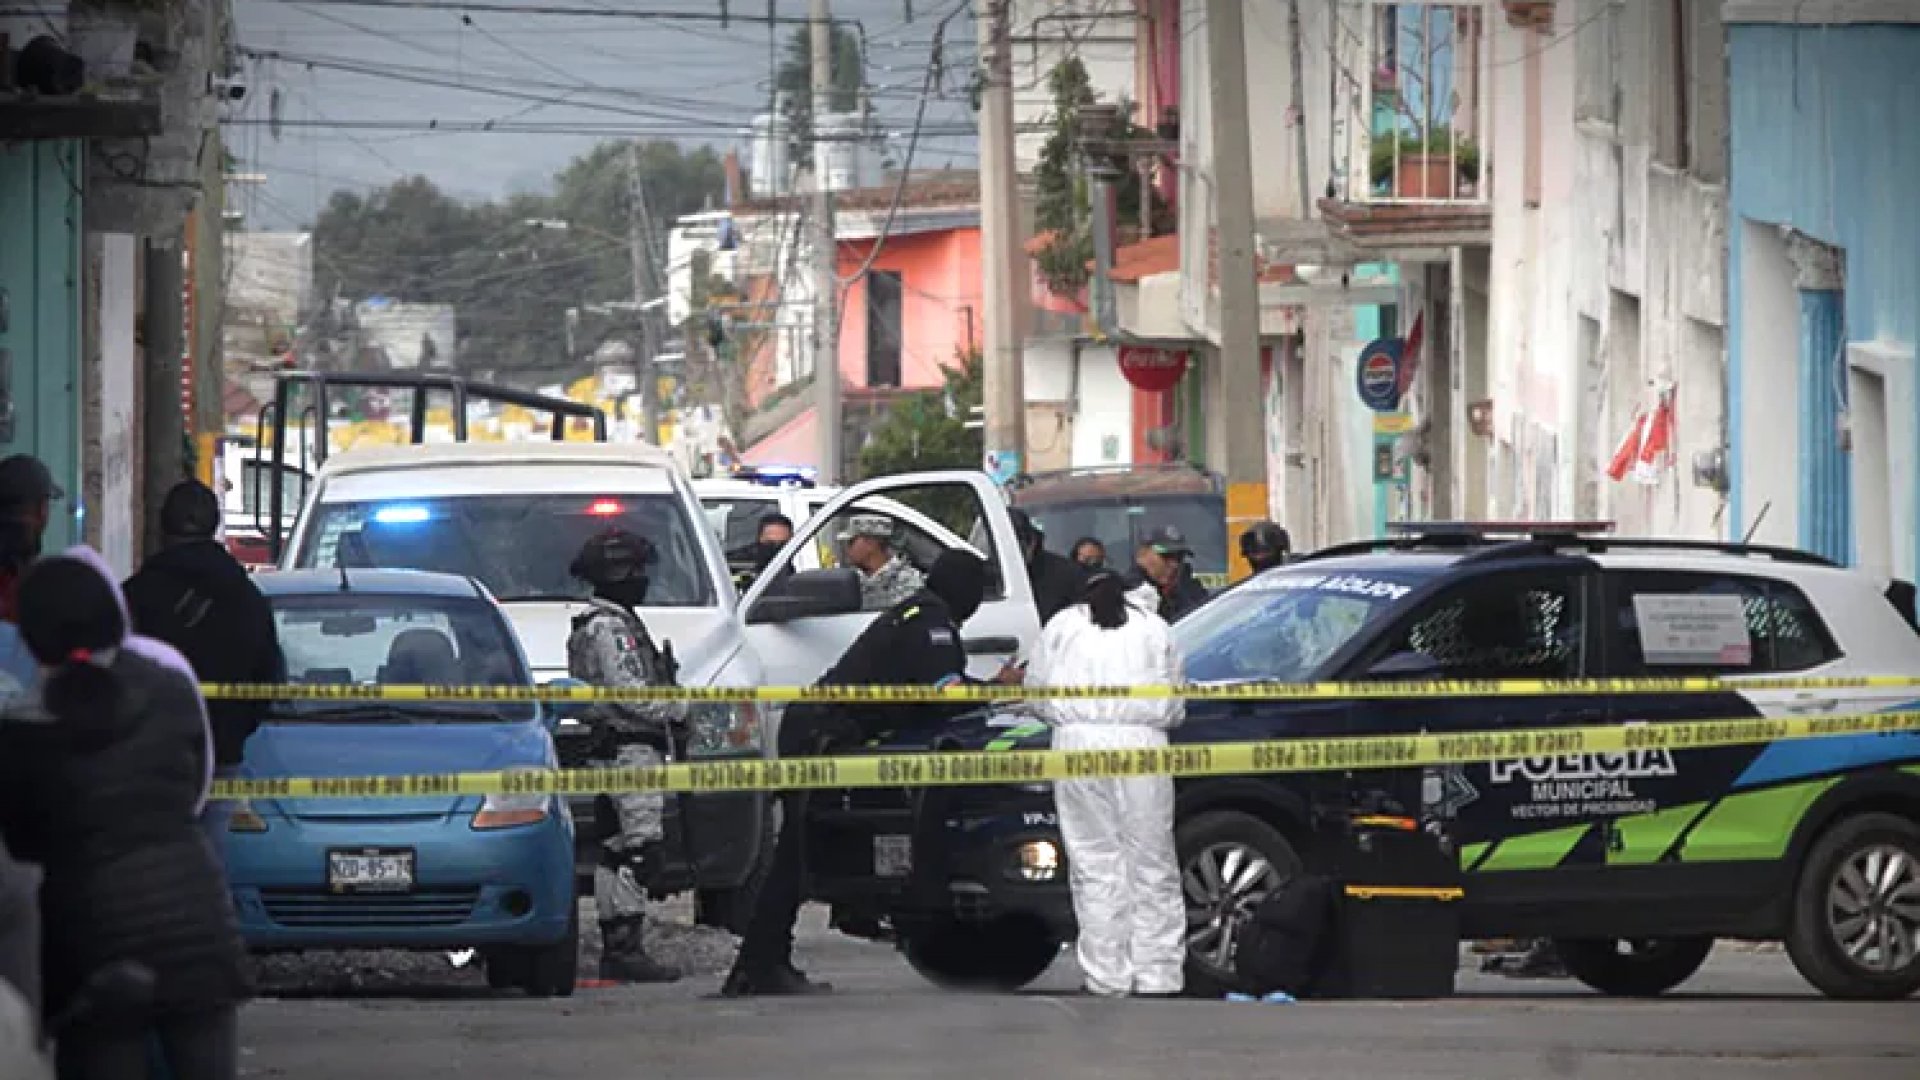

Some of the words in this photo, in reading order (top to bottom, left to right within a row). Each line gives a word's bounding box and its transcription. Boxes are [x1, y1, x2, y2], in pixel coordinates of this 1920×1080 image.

[1325, 739, 1416, 764] PROHIBIDO
[1439, 735, 1503, 759] POLICIA
[1510, 734, 1529, 756] DE
[1536, 731, 1583, 753] LINEA
[951, 755, 1043, 779] PROHIBIDO
[1065, 751, 1132, 776] POLICIA
[1137, 750, 1157, 773] DE
[1162, 748, 1212, 773] LINEA
[1252, 745, 1295, 769] PASO
[1301, 744, 1319, 766] EL
[575, 768, 668, 792] PROHIBIDO
[690, 763, 755, 788] POLICIA
[762, 761, 781, 785] DE
[788, 759, 837, 784] LINEA
[878, 758, 922, 782] PASO
[929, 757, 945, 779] EL
[501, 772, 543, 793] PASO
[551, 770, 569, 791] EL
[1531, 780, 1635, 801] MUNICIPAL
[1511, 803, 1560, 818] VECTOR
[1564, 803, 1578, 816] DE
